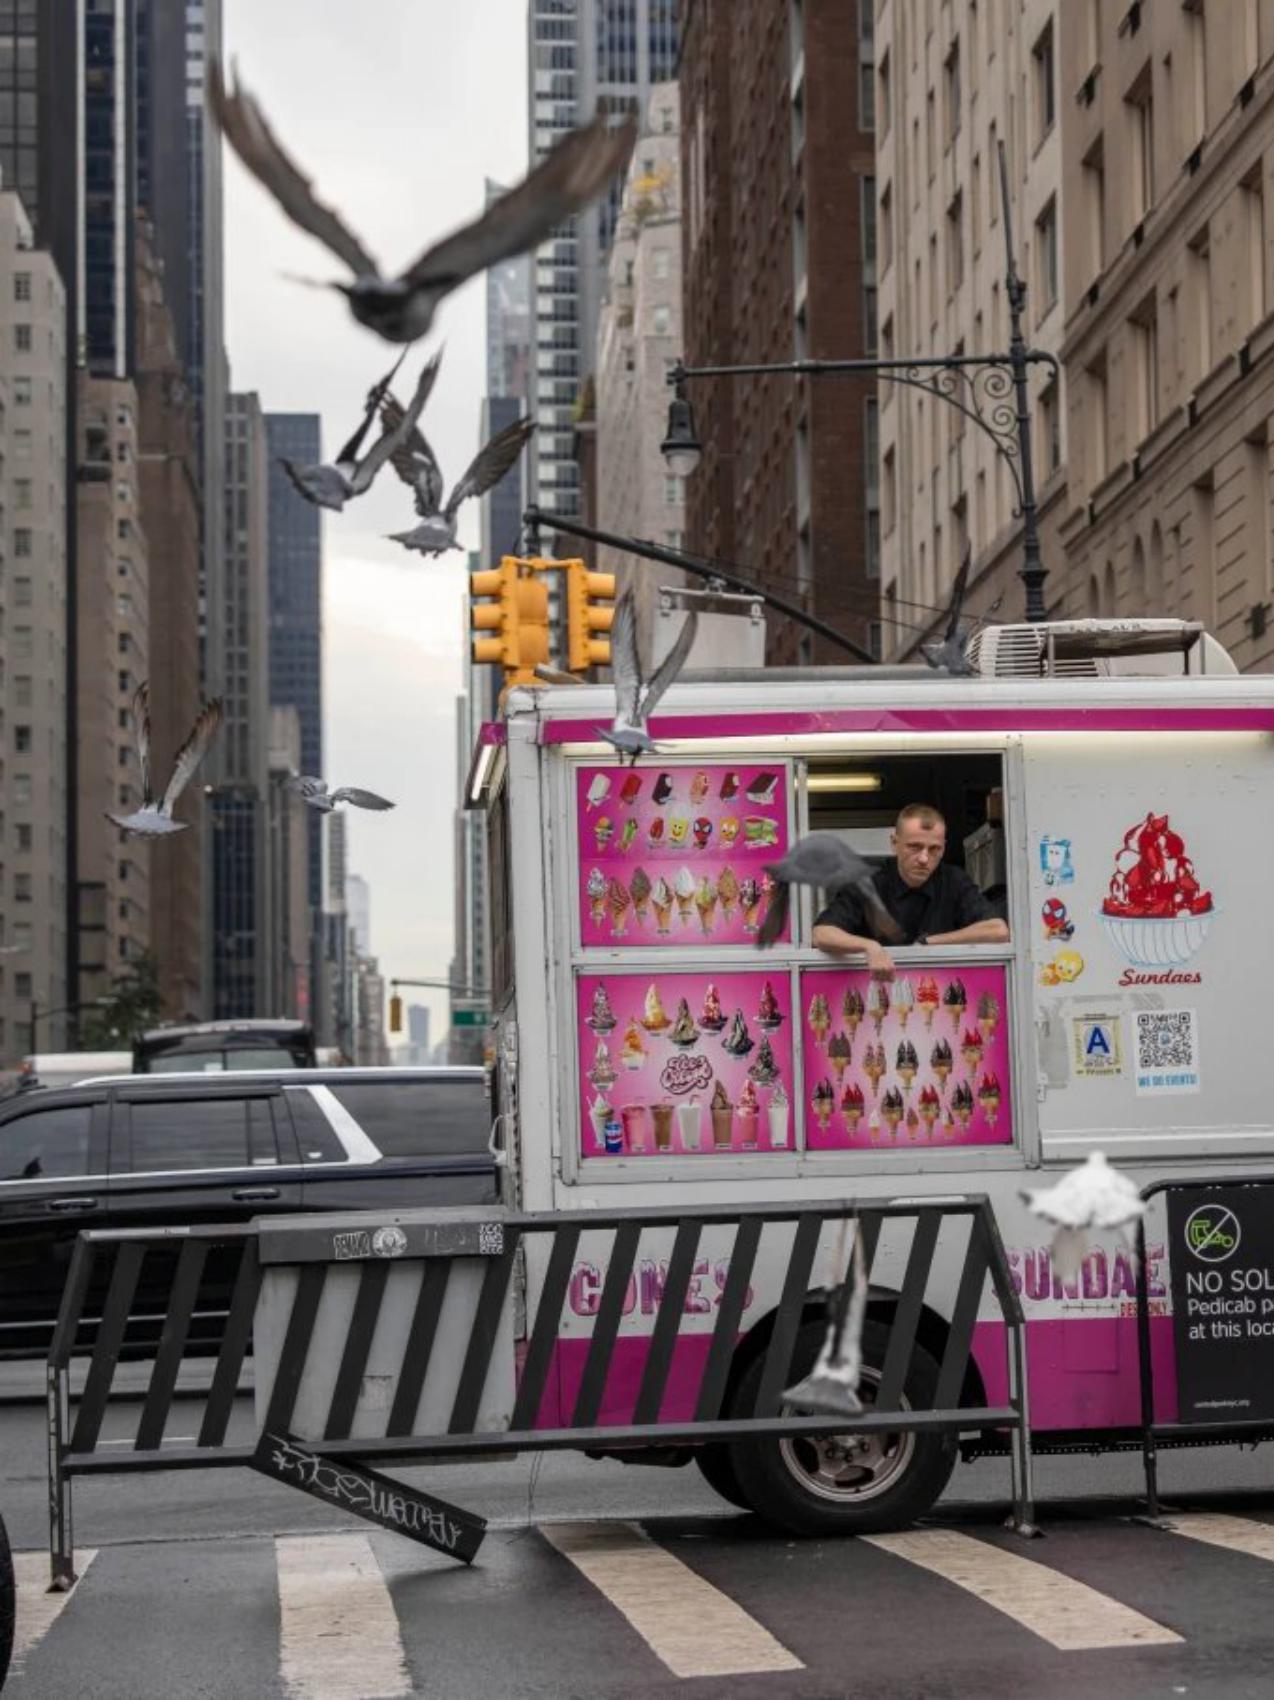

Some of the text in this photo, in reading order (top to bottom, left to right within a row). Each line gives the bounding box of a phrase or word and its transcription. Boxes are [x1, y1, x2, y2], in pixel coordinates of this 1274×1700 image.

[1118, 968, 1202, 987] Sundaes
[1086, 1026, 1110, 1054] A
[1186, 1271, 1223, 1294] NO
[1188, 1297, 1256, 1317] Pedicab
[1189, 1323, 1206, 1340] at
[1211, 1320, 1242, 1338] this
